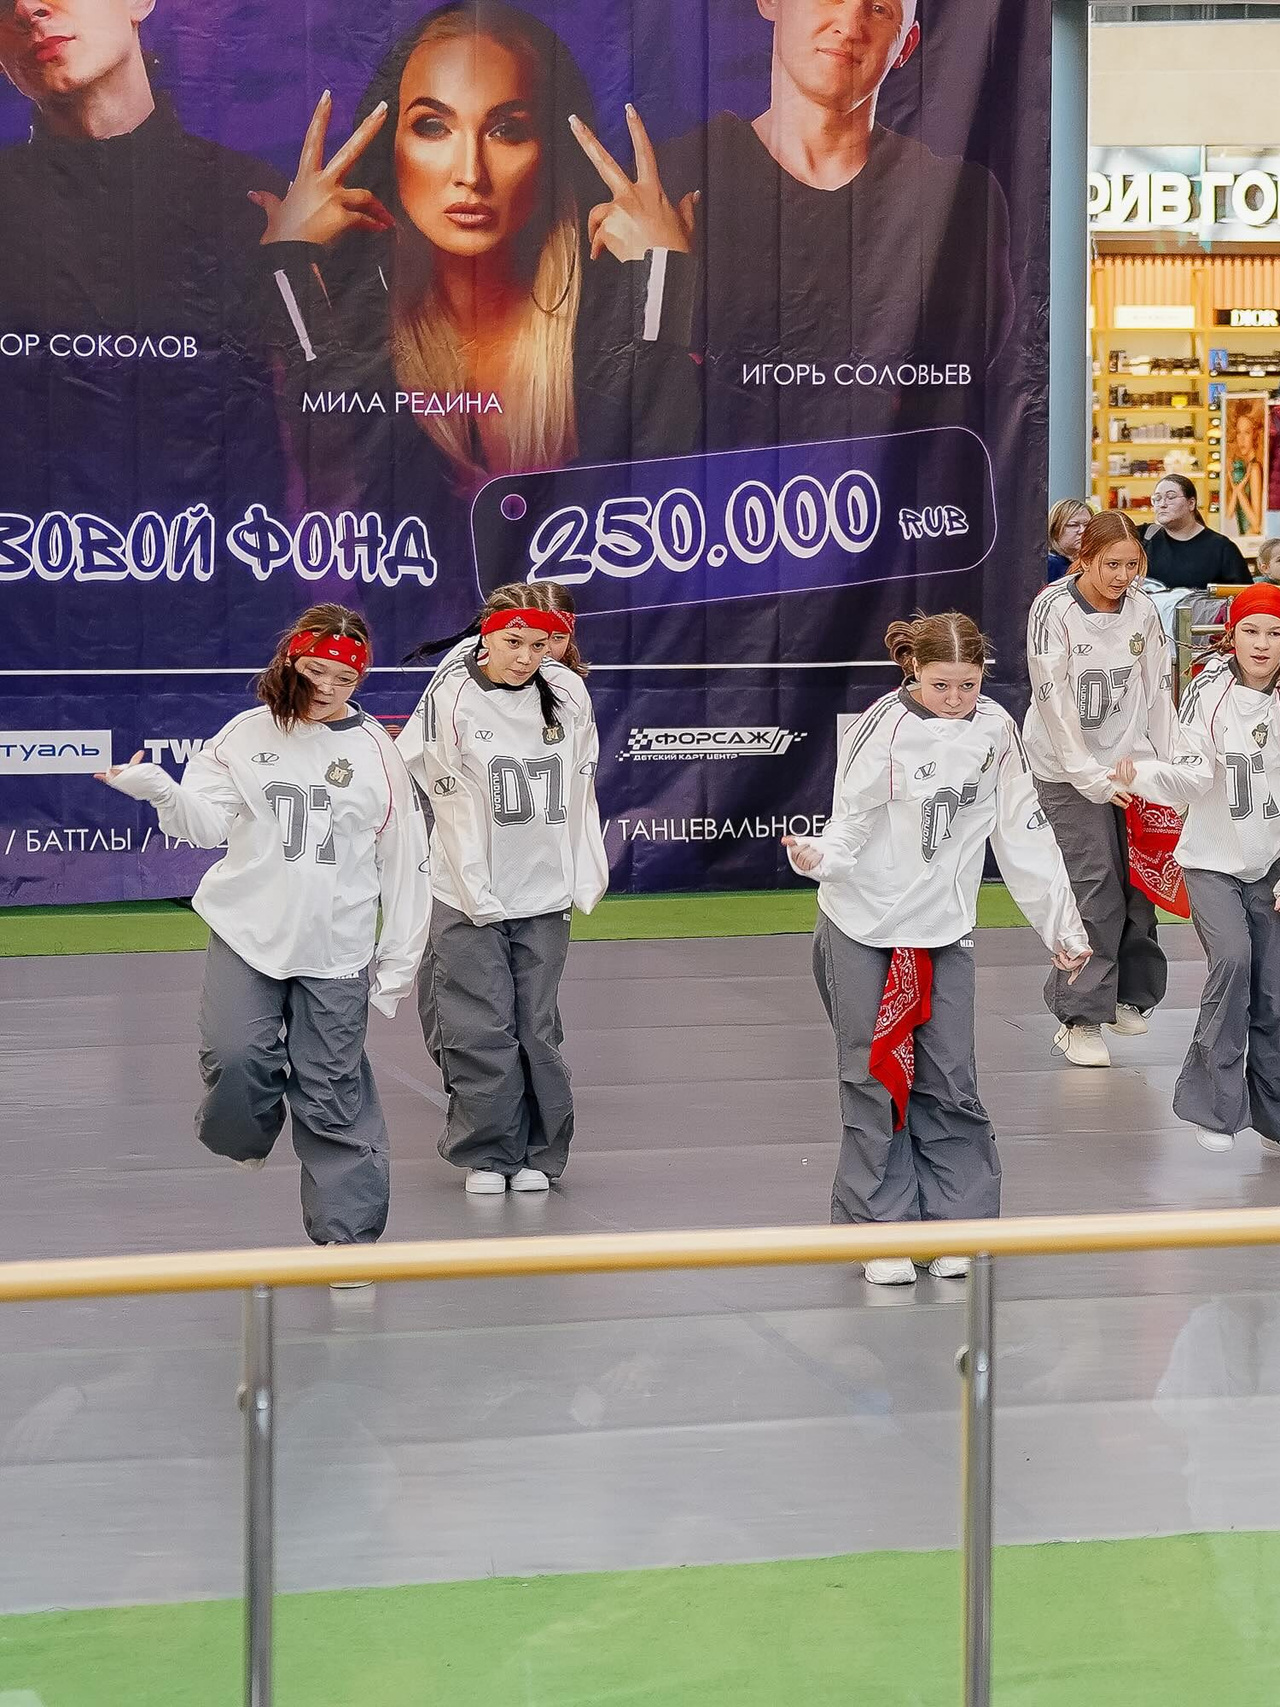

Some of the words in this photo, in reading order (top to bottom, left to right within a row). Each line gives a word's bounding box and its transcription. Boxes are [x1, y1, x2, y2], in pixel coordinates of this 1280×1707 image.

[49, 333, 198, 358] СОКОЛОВ
[742, 363, 826, 386] ИГОРЬ
[834, 363, 972, 387] СОЛОВЬЕВ
[301, 391, 387, 414] МИЛА
[395, 391, 504, 416] РЕДИНА
[526, 469, 881, 586] 250.000
[899, 505, 969, 541] RUB
[226, 503, 438, 588] ФОНД
[654, 730, 771, 746] ФОРСАЖ
[633, 753, 677, 761] ДЕТСКИЙ
[678, 753, 705, 761] КАРТ
[706, 753, 738, 761] ЦЕНТР
[487, 753, 568, 827] 07
[26, 828, 131, 853] БАТТЛЫ
[617, 814, 826, 843] ТАНЦЕВАЛЬНОЕ
